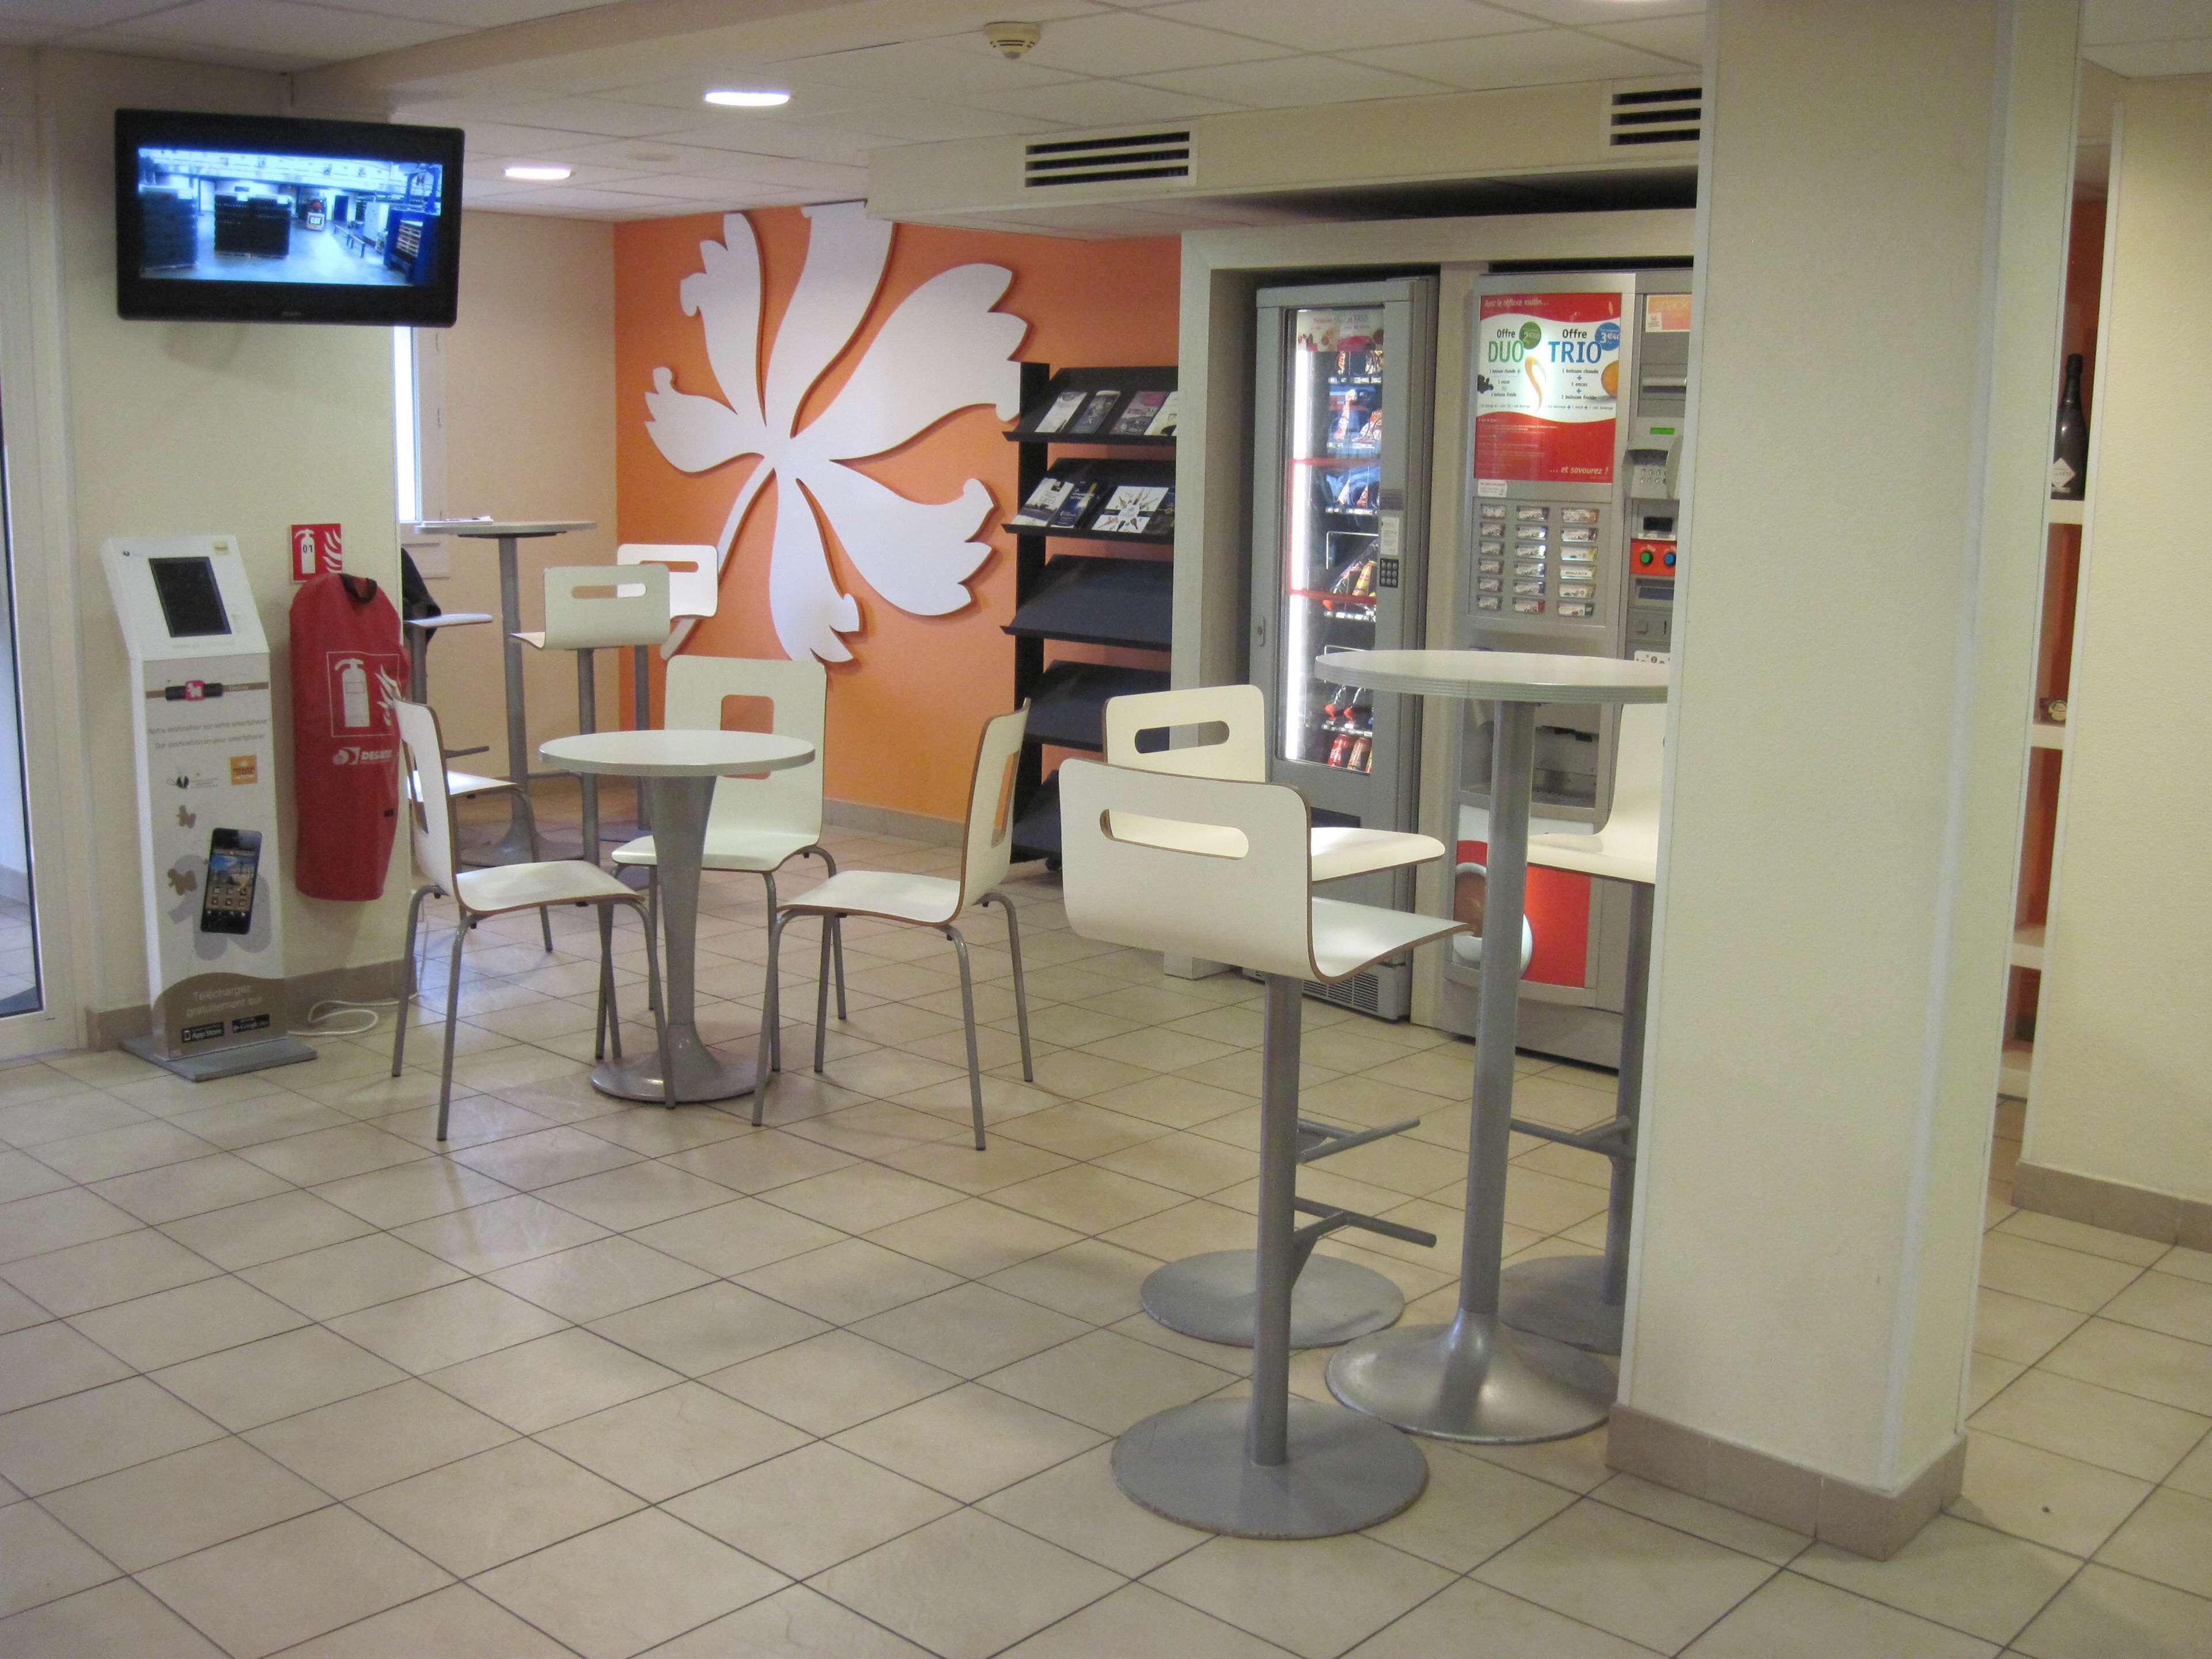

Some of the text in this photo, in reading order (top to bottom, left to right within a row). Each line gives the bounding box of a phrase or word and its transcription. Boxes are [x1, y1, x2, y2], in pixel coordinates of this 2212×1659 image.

[1497, 328, 1516, 339] Offre
[1562, 328, 1587, 339] Offre
[1488, 340, 1524, 363] DUO
[1548, 340, 1602, 364] TRIO
[1570, 467, 1603, 475] savourez
[302, 544, 313, 553] 01
[192, 1031, 206, 1040] App
